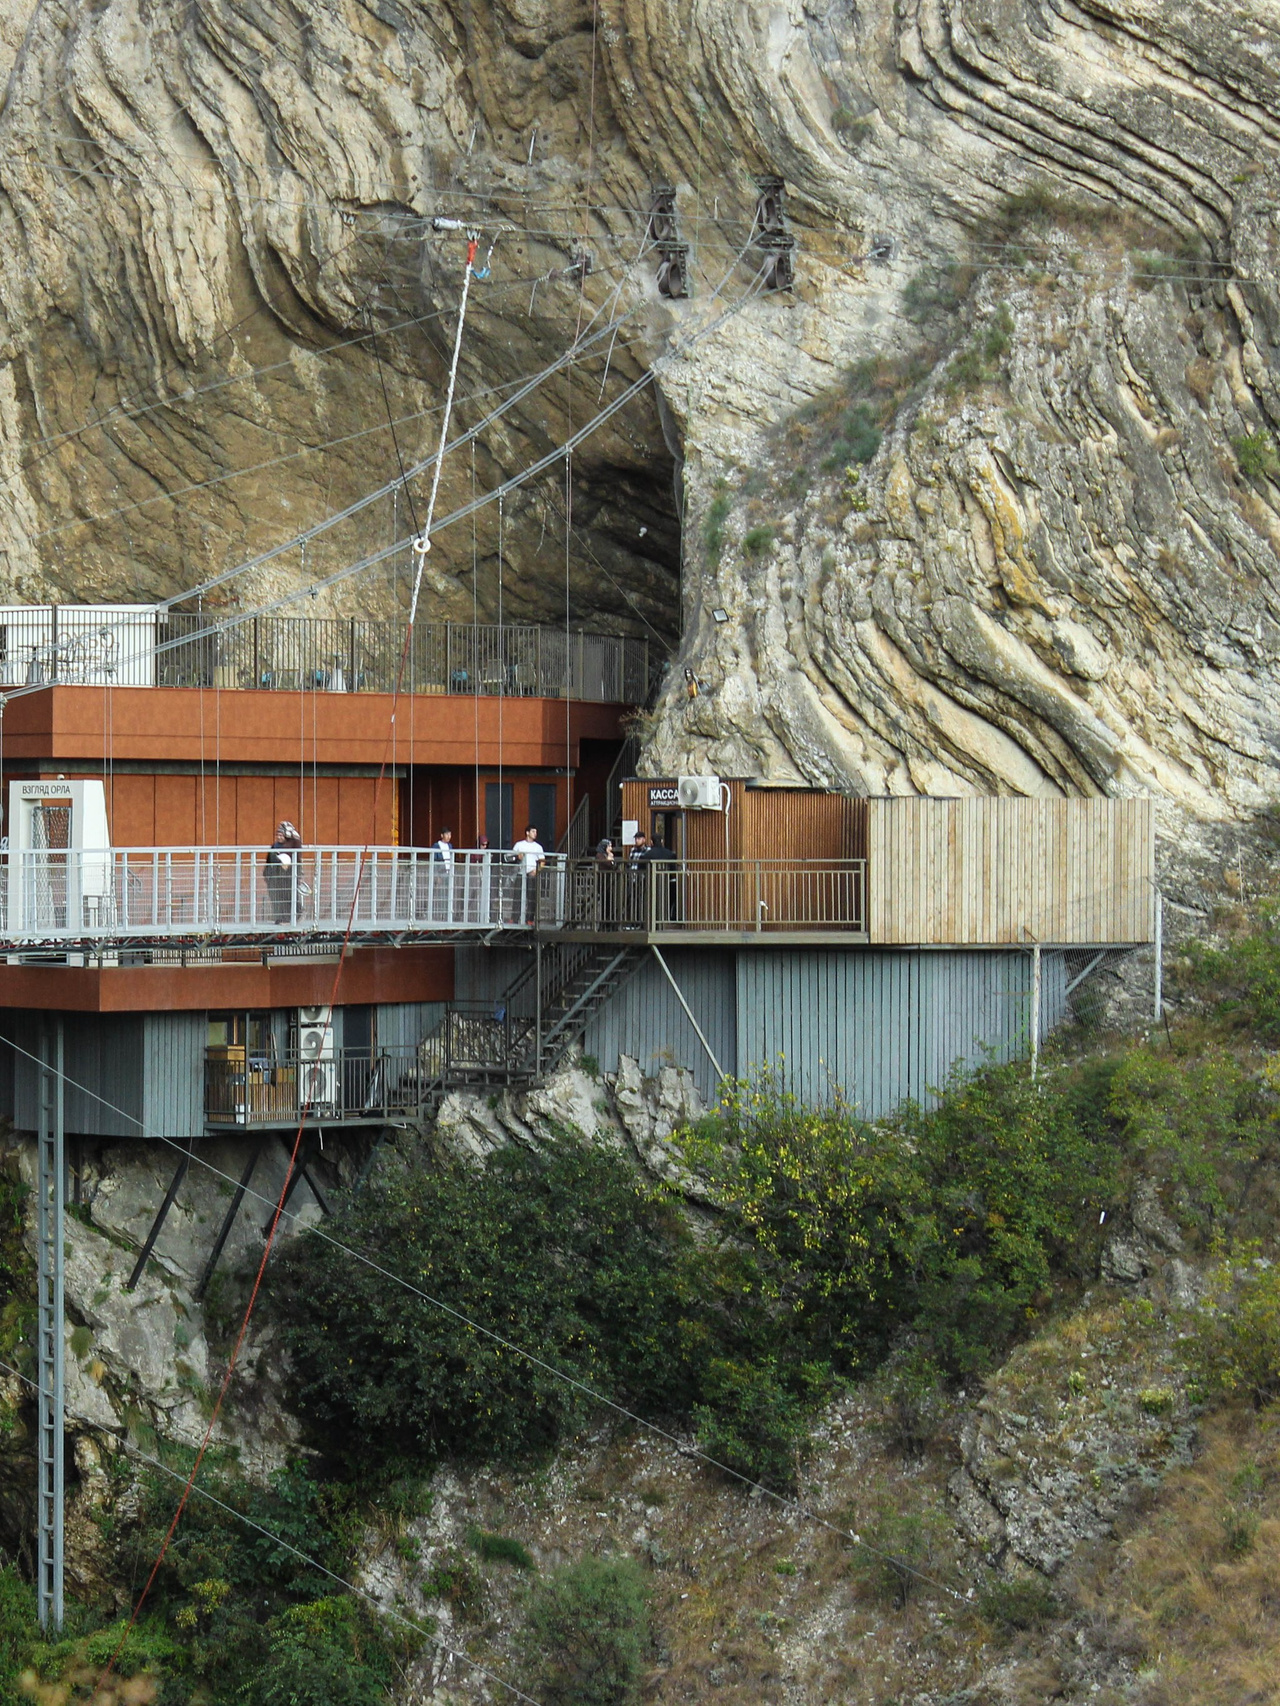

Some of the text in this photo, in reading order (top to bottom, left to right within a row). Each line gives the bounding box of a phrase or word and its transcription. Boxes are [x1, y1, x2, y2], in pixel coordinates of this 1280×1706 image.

[22, 785, 71, 796] ВЗГЛЯД ОРЛА
[650, 789, 679, 800] КАССА
